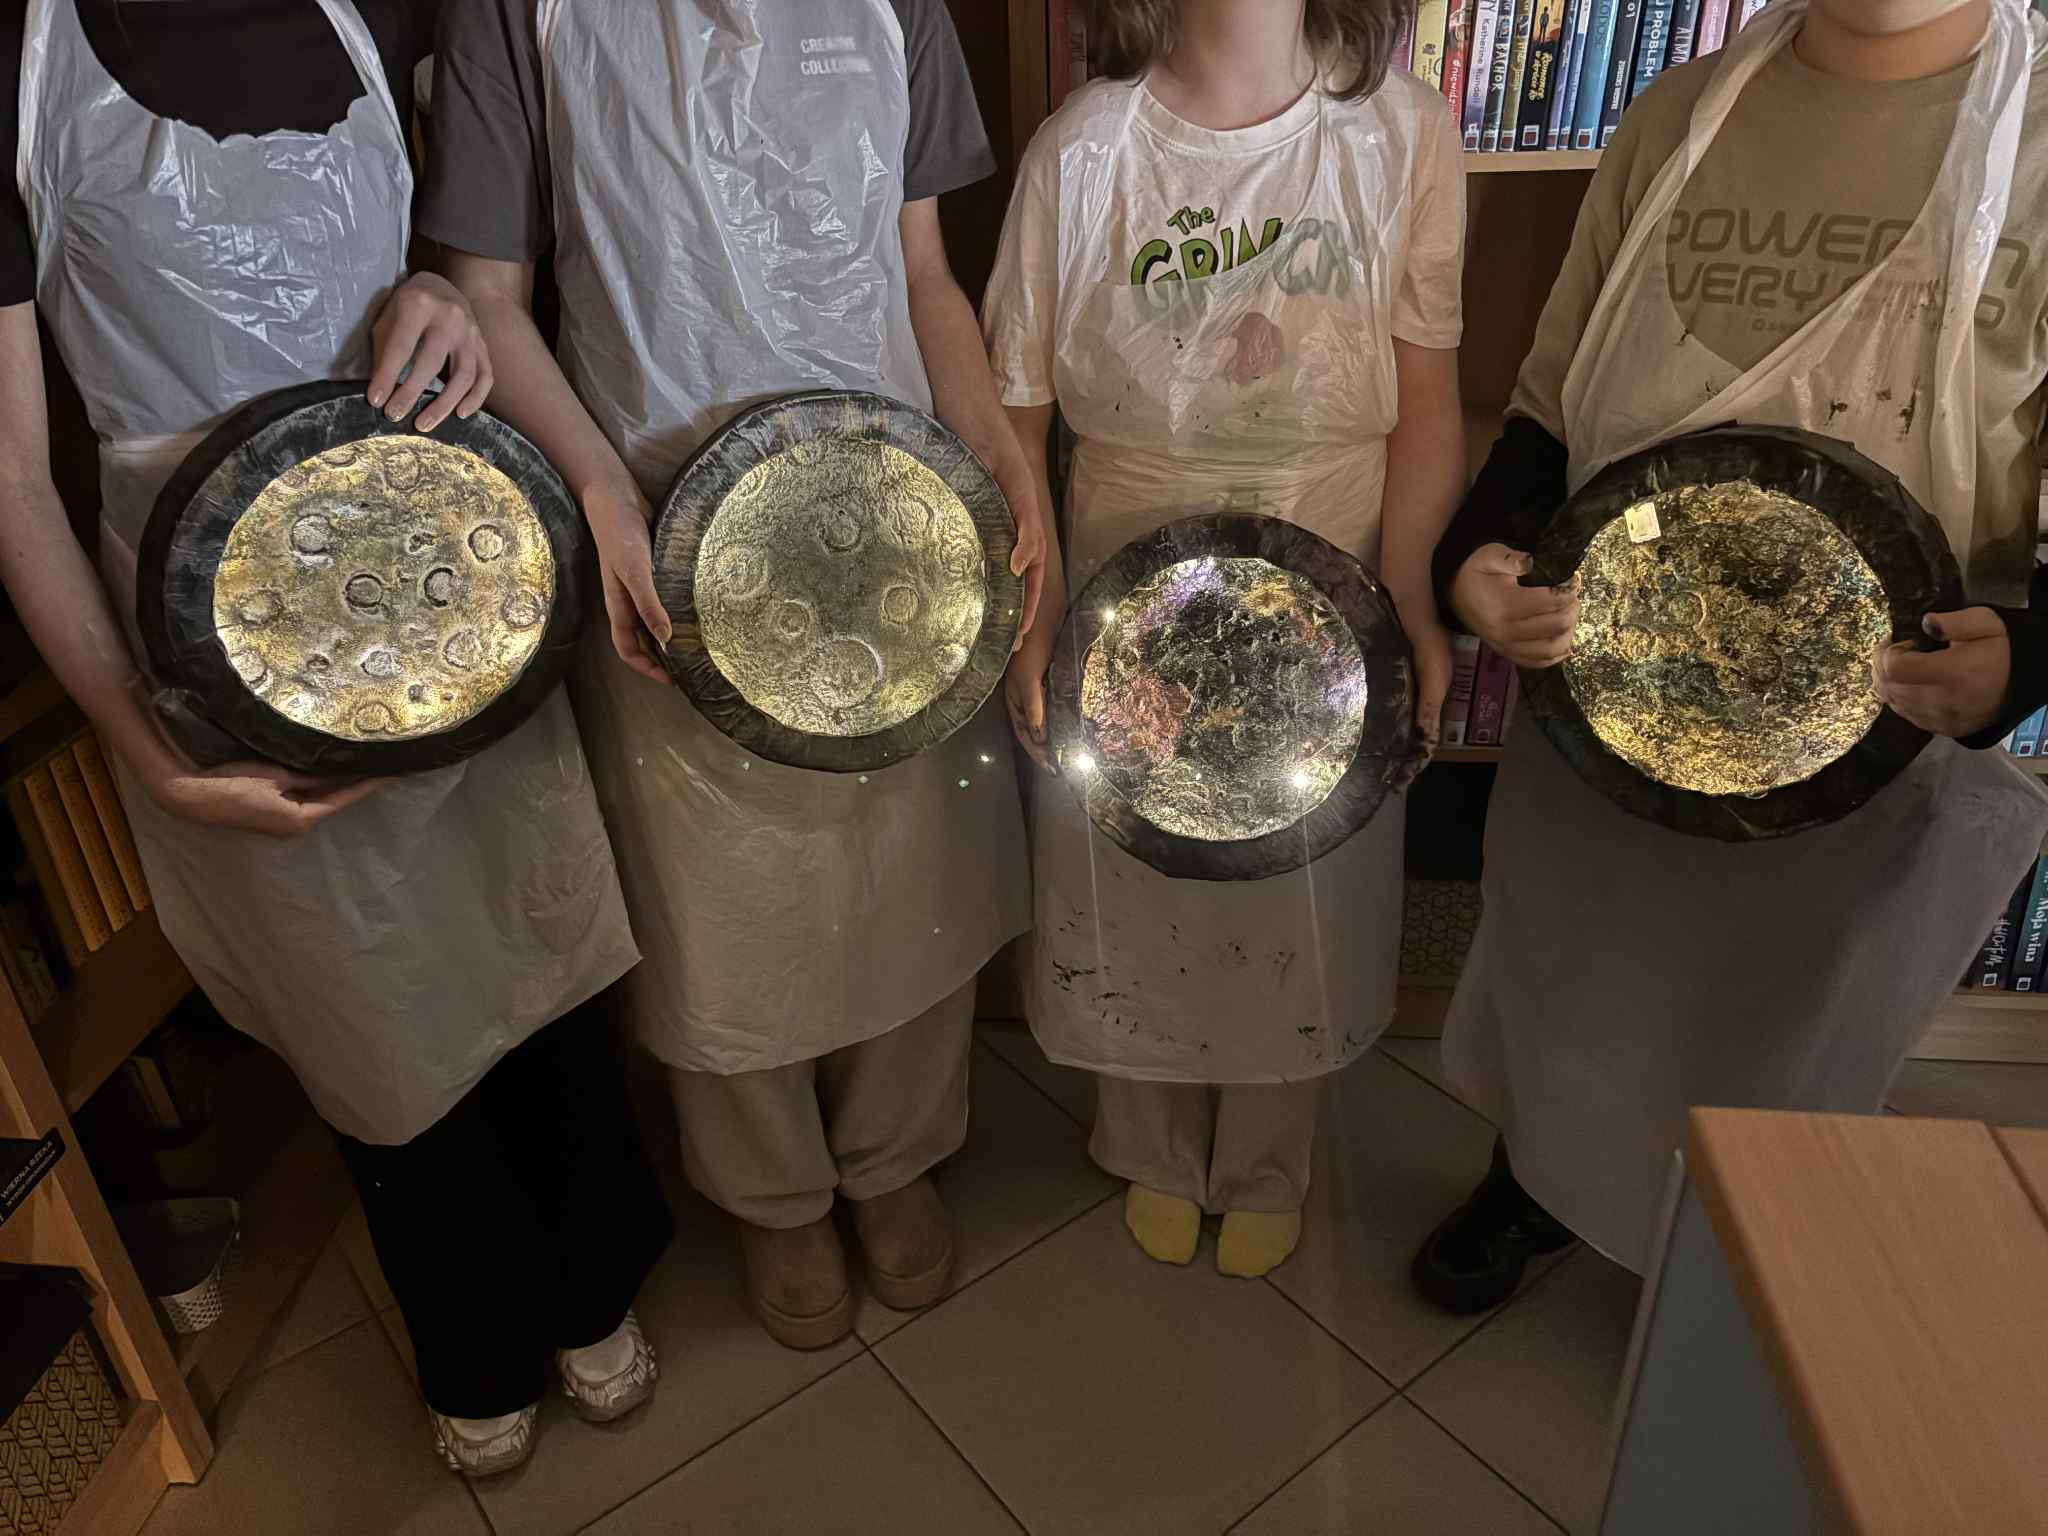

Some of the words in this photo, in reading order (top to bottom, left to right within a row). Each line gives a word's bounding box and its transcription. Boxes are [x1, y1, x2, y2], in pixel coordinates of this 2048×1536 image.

[1476, 18, 1491, 64] Katherine
[1643, 10, 1664, 78] PROBLEM
[1472, 67, 1485, 104] Rundell
[1490, 42, 1509, 93] BACHOR
[1166, 205, 1216, 236] The
[2024, 932, 2041, 962] wina
